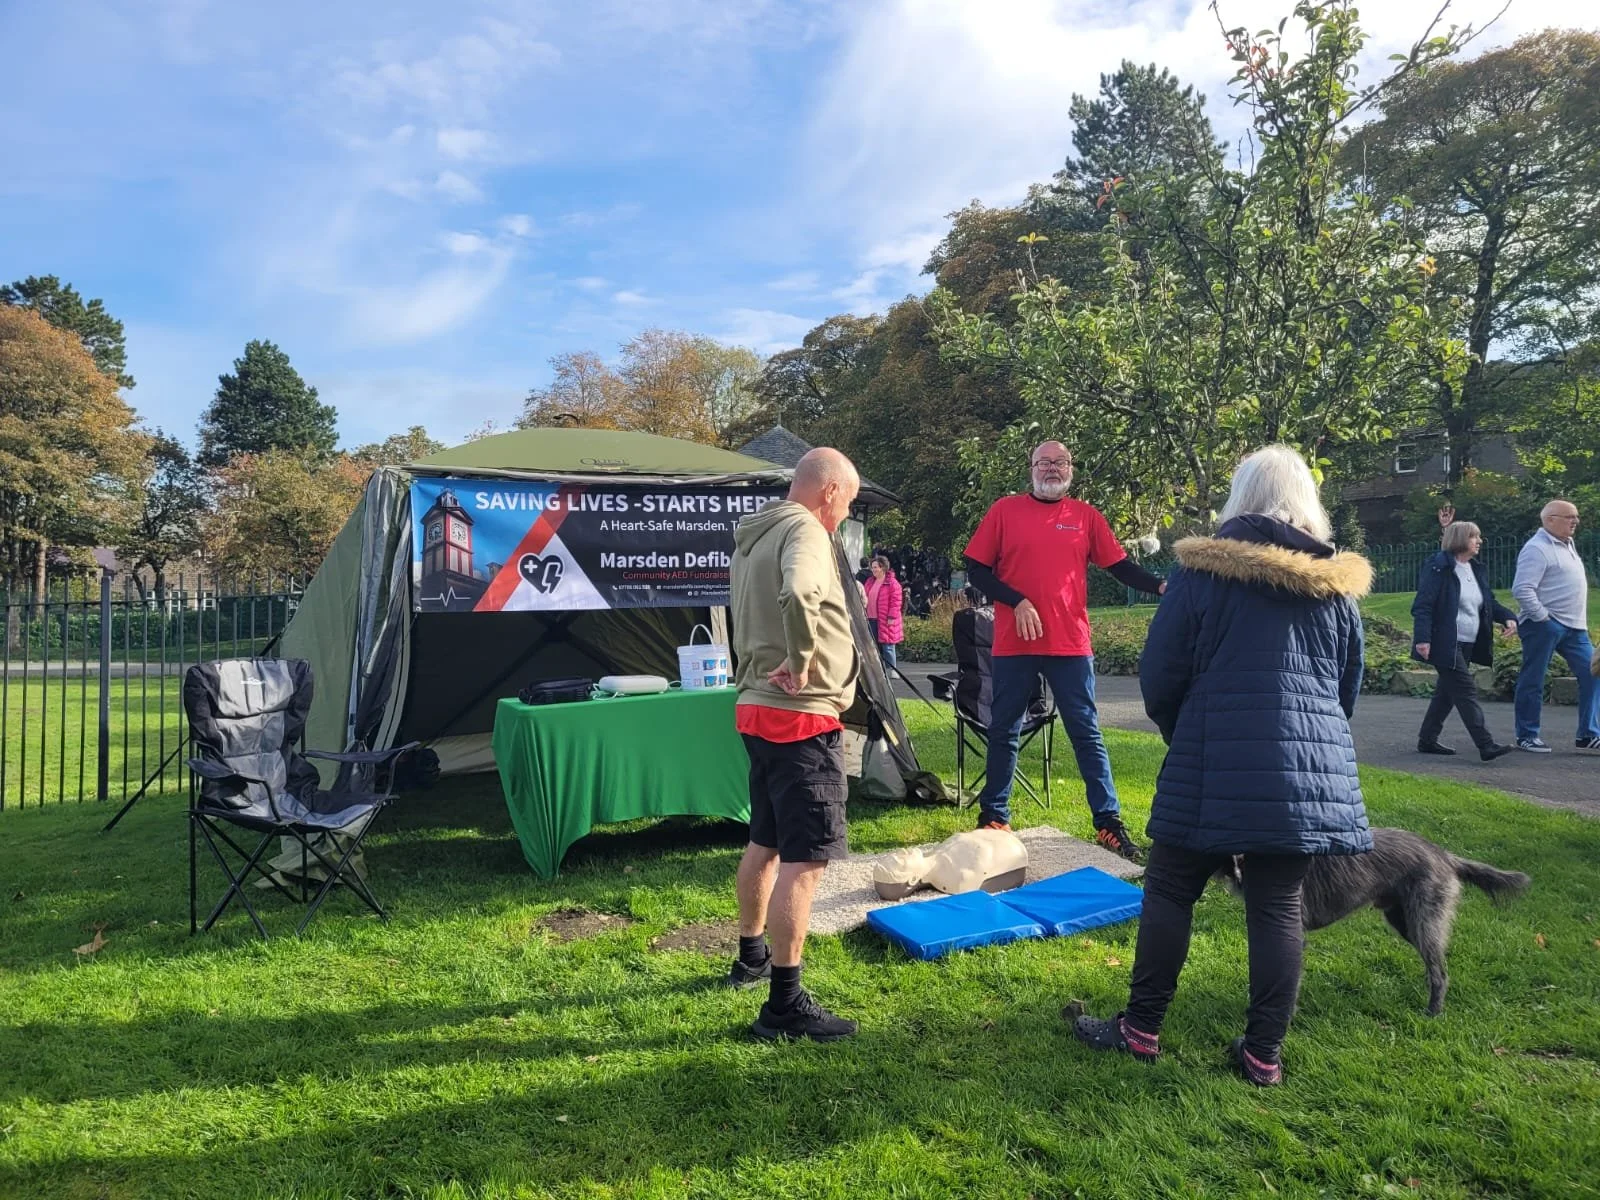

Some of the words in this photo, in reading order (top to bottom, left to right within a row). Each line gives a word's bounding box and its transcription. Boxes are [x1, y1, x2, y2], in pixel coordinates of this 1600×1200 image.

[475, 491, 561, 511] SAVING
[567, 493, 629, 512] LIVES
[726, 495, 781, 513] HER
[600, 520, 608, 531] A
[611, 519, 673, 532] Heart-Safe
[676, 519, 729, 532] Marsden.
[600, 551, 680, 569] Marsden
[622, 570, 670, 580] Community
[671, 570, 688, 579] AED
[690, 570, 730, 579] Fundraise
